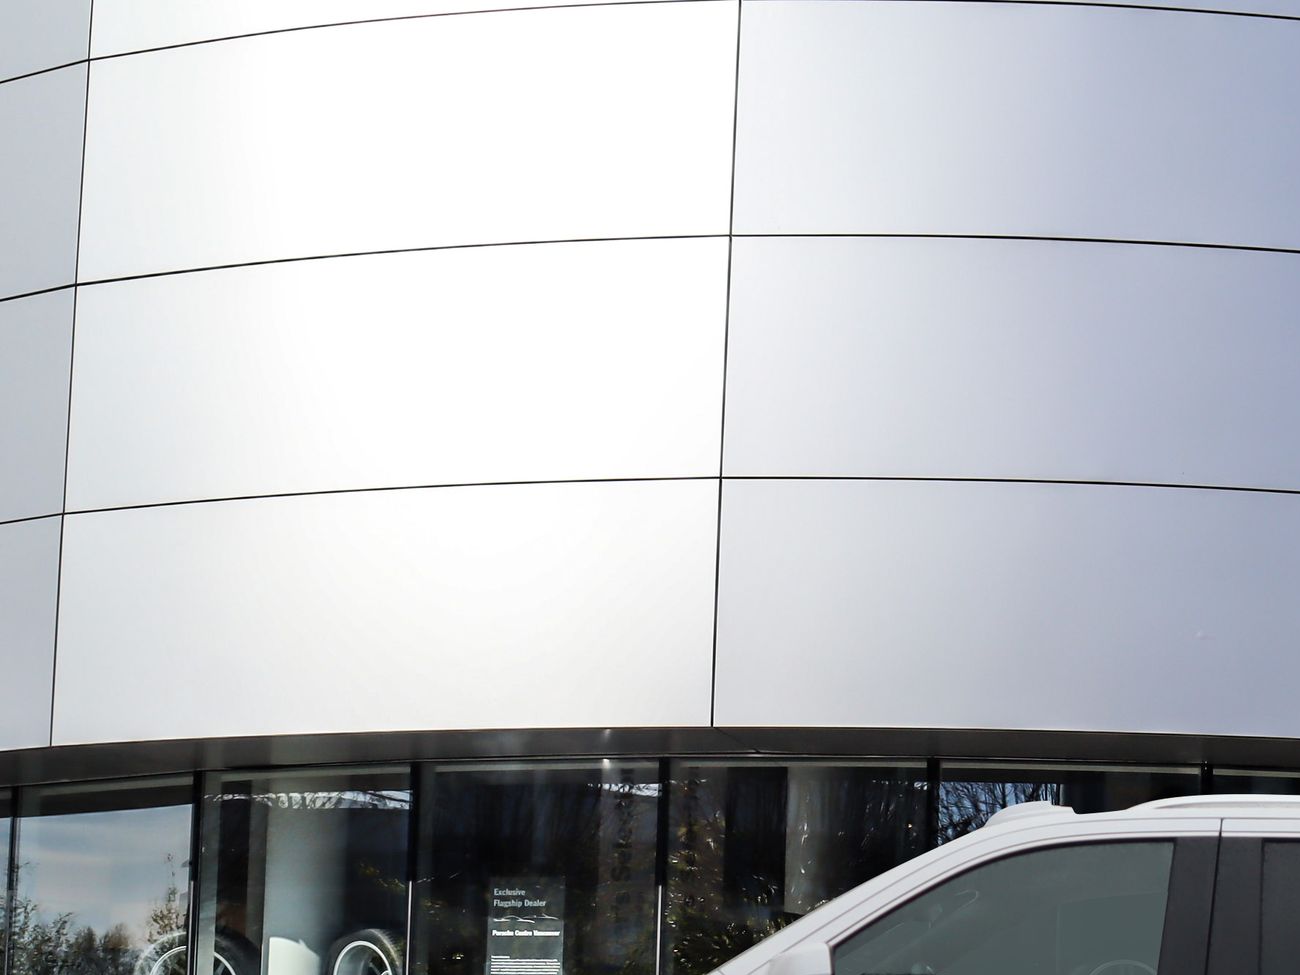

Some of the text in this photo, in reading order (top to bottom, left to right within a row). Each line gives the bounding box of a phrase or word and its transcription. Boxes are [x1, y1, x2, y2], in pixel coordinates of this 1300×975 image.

[493, 888, 526, 896] Exclusive
[493, 899, 547, 908] Flagship Dealer
